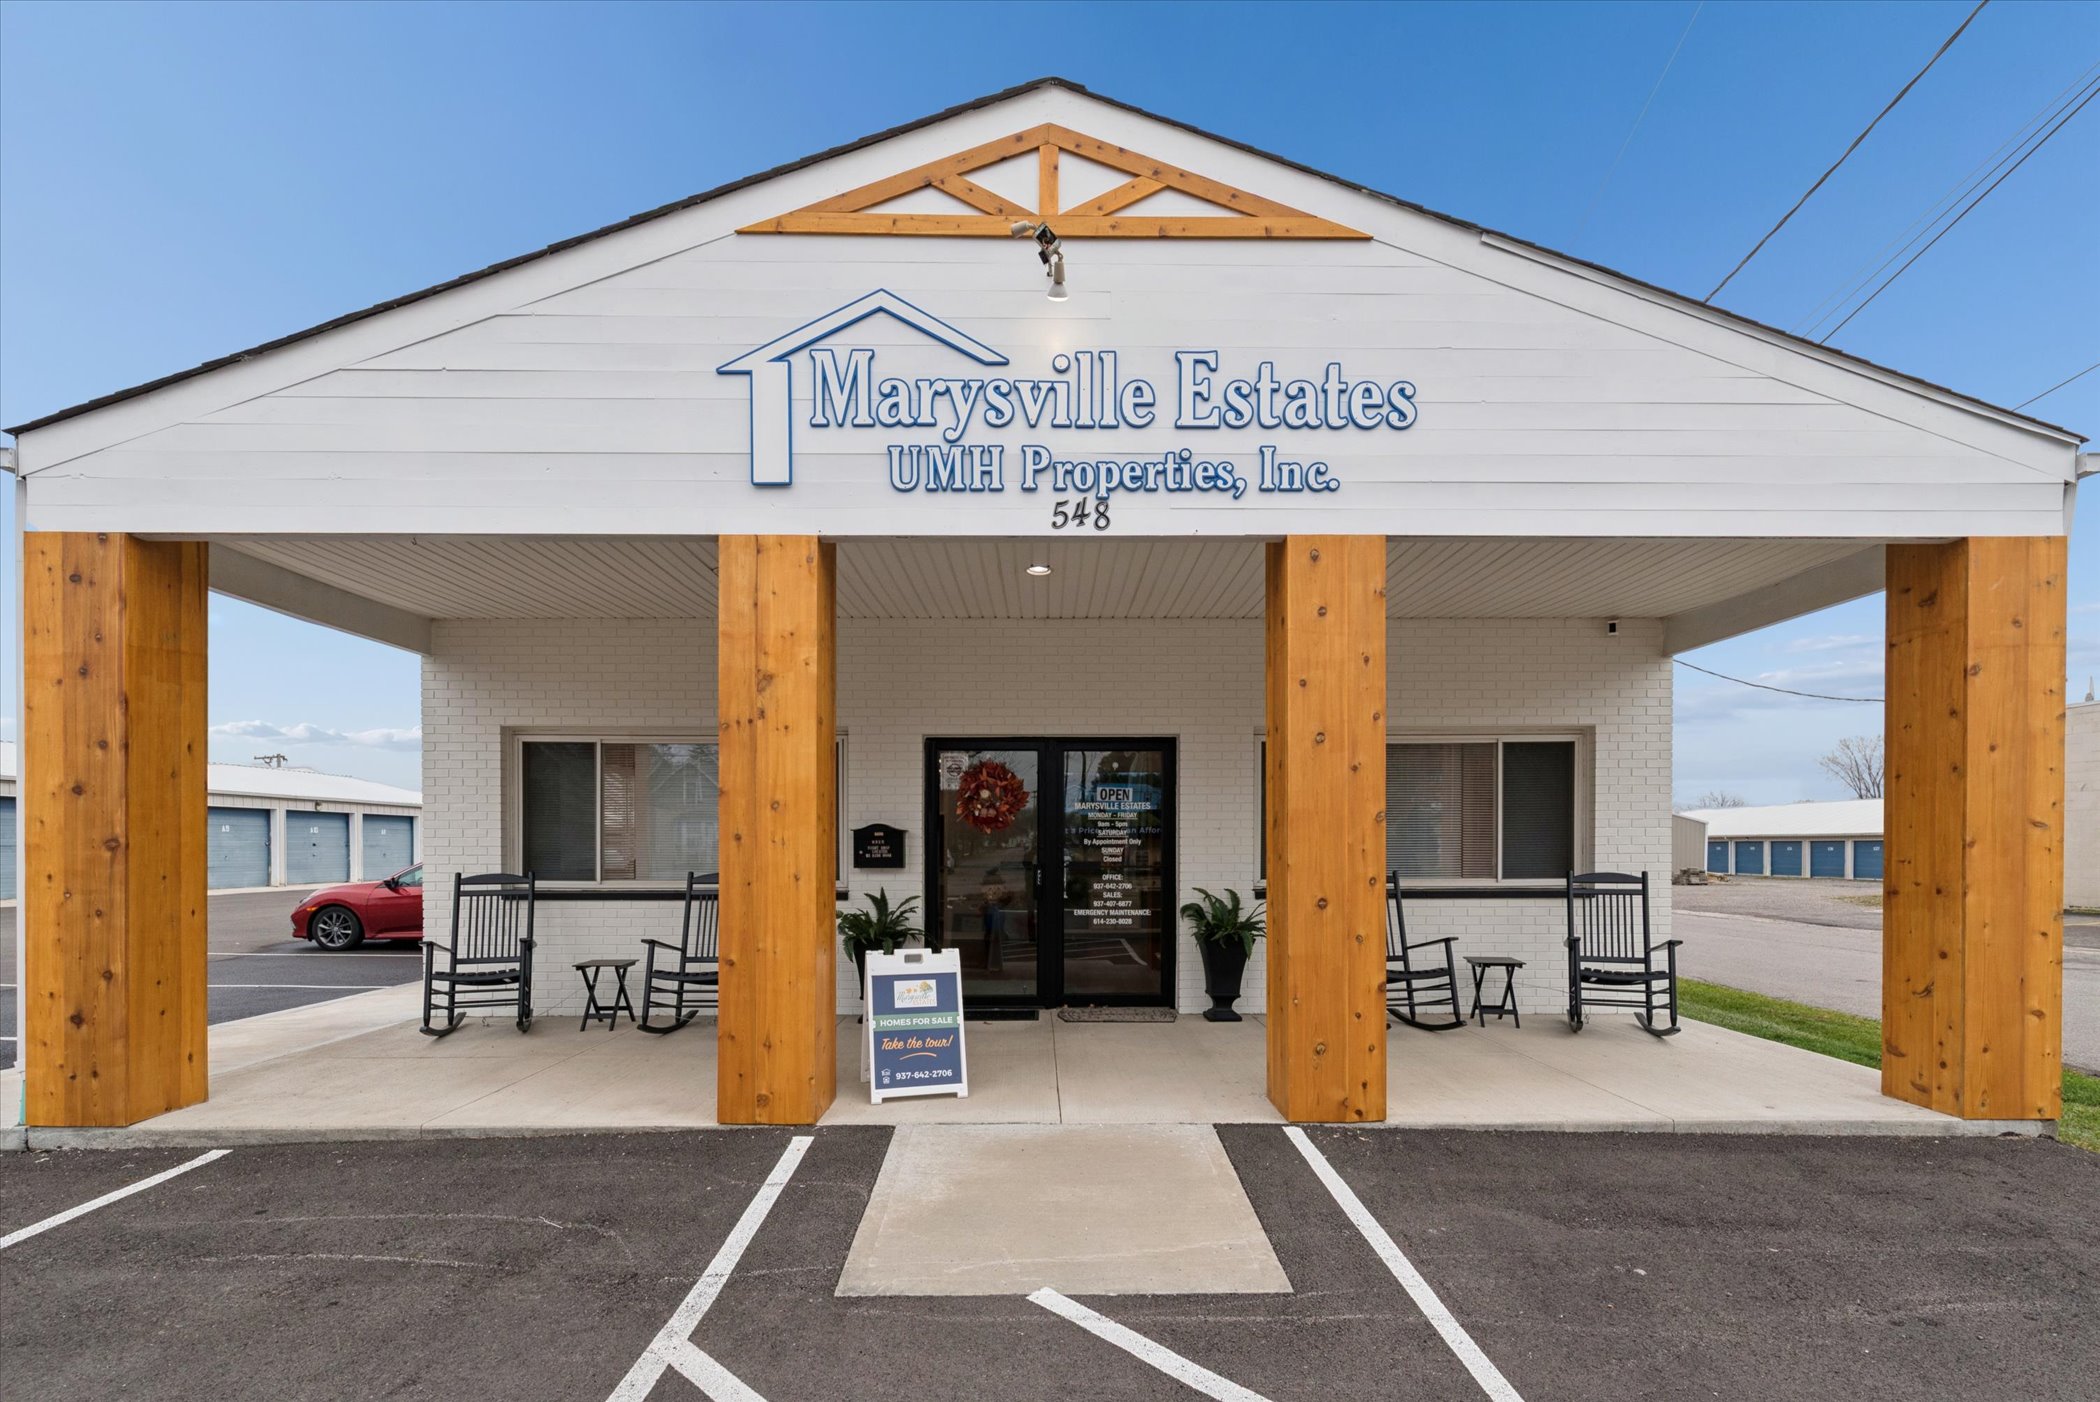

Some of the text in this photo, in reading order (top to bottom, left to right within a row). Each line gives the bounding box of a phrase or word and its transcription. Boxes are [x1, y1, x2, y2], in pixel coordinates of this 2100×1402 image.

[808, 348, 1418, 443] Marysville Estates
[887, 444, 1341, 501] UMH Properties, Inc.
[1051, 496, 1111, 531] 548
[1100, 788, 1130, 801] OPEN
[1074, 801, 1152, 810] MARYSVILLE ESTATES
[1097, 820, 1110, 828] 9am
[1115, 820, 1128, 829] 5pm
[1097, 829, 1128, 837] SATURDAY
[1083, 838, 1142, 846] By Appointment Only
[1101, 847, 1125, 855] SUNDAY
[1102, 855, 1123, 863] Closed
[1102, 873, 1124, 881] OFFICE:
[880, 1016, 953, 1027] HOMES FOR SALE
[881, 1034, 954, 1051] Take the tour!
[895, 1069, 953, 1081] 937-642-2706
